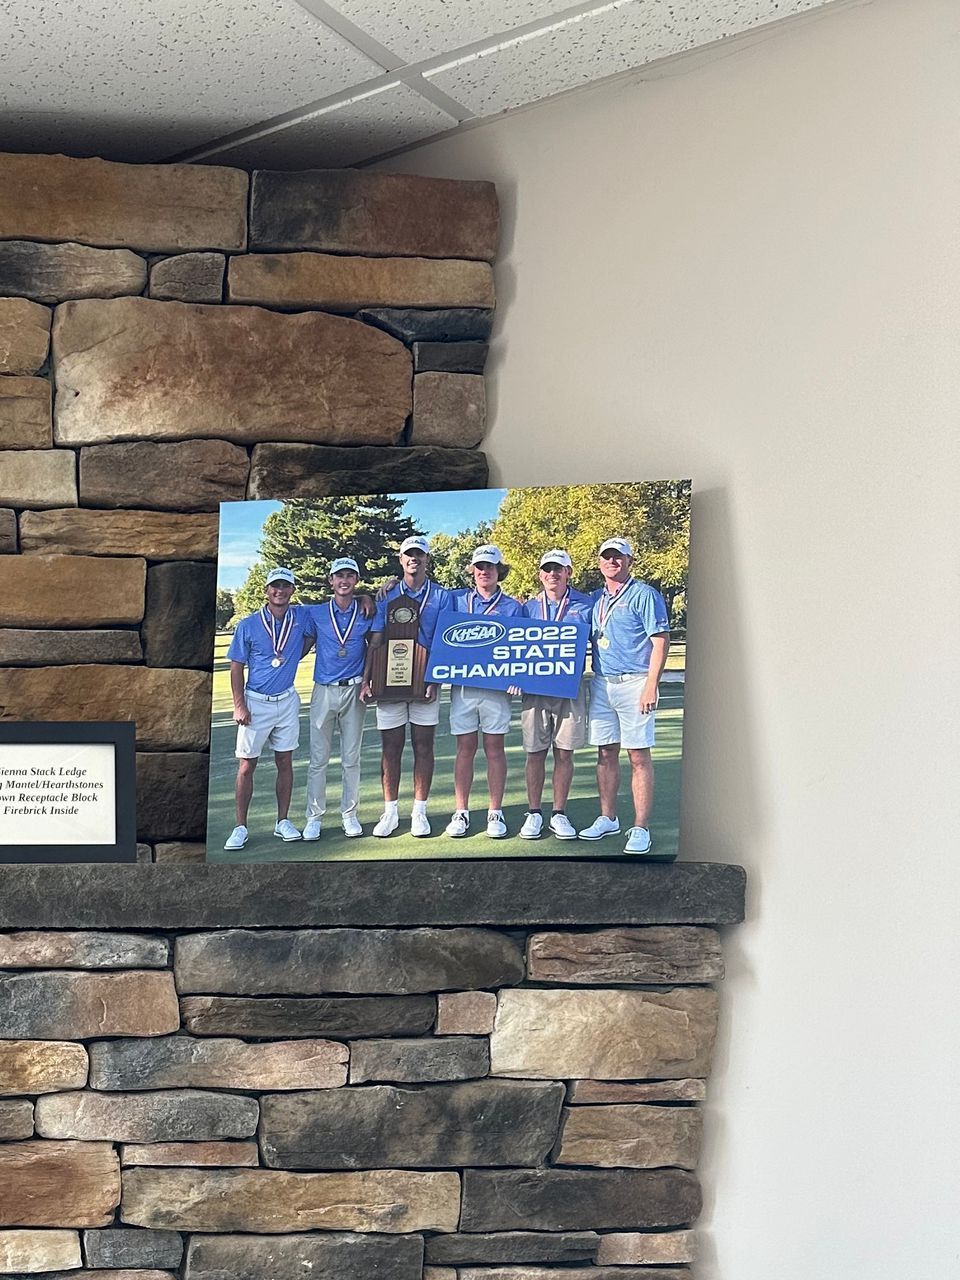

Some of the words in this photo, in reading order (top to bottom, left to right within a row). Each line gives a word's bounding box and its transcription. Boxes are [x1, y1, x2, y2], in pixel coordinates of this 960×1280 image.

[450, 625, 497, 642] KHSAA
[507, 625, 578, 642] 2022
[492, 643, 576, 660] STATE
[432, 661, 575, 679] CHAMPION
[30, 767, 56, 776] Stack
[58, 767, 87, 778] Ledge
[5, 779, 104, 789] Mantel/Hearthstones
[18, 793, 68, 804] Receptacle
[71, 793, 98, 802] Block
[3, 806, 48, 815] Firebrick
[49, 806, 80, 815] Inside
